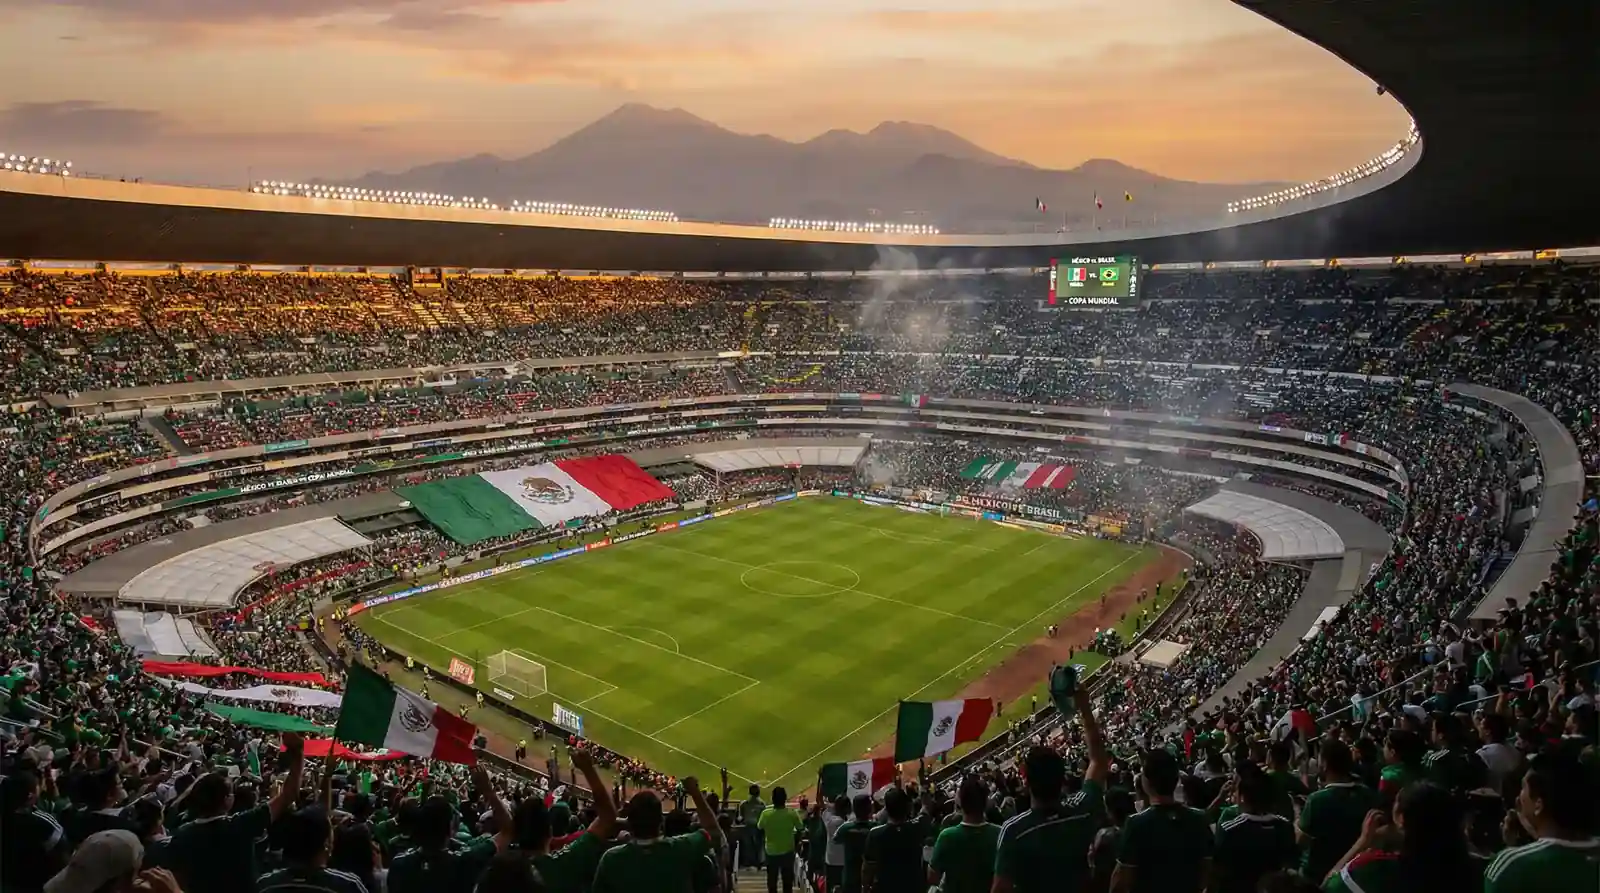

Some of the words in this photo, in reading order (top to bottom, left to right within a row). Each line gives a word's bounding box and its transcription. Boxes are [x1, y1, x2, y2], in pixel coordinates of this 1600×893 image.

[1069, 297, 1087, 305] COPA
[1088, 297, 1119, 305] MUNDIAL
[1027, 506, 1063, 519] BRASIL
